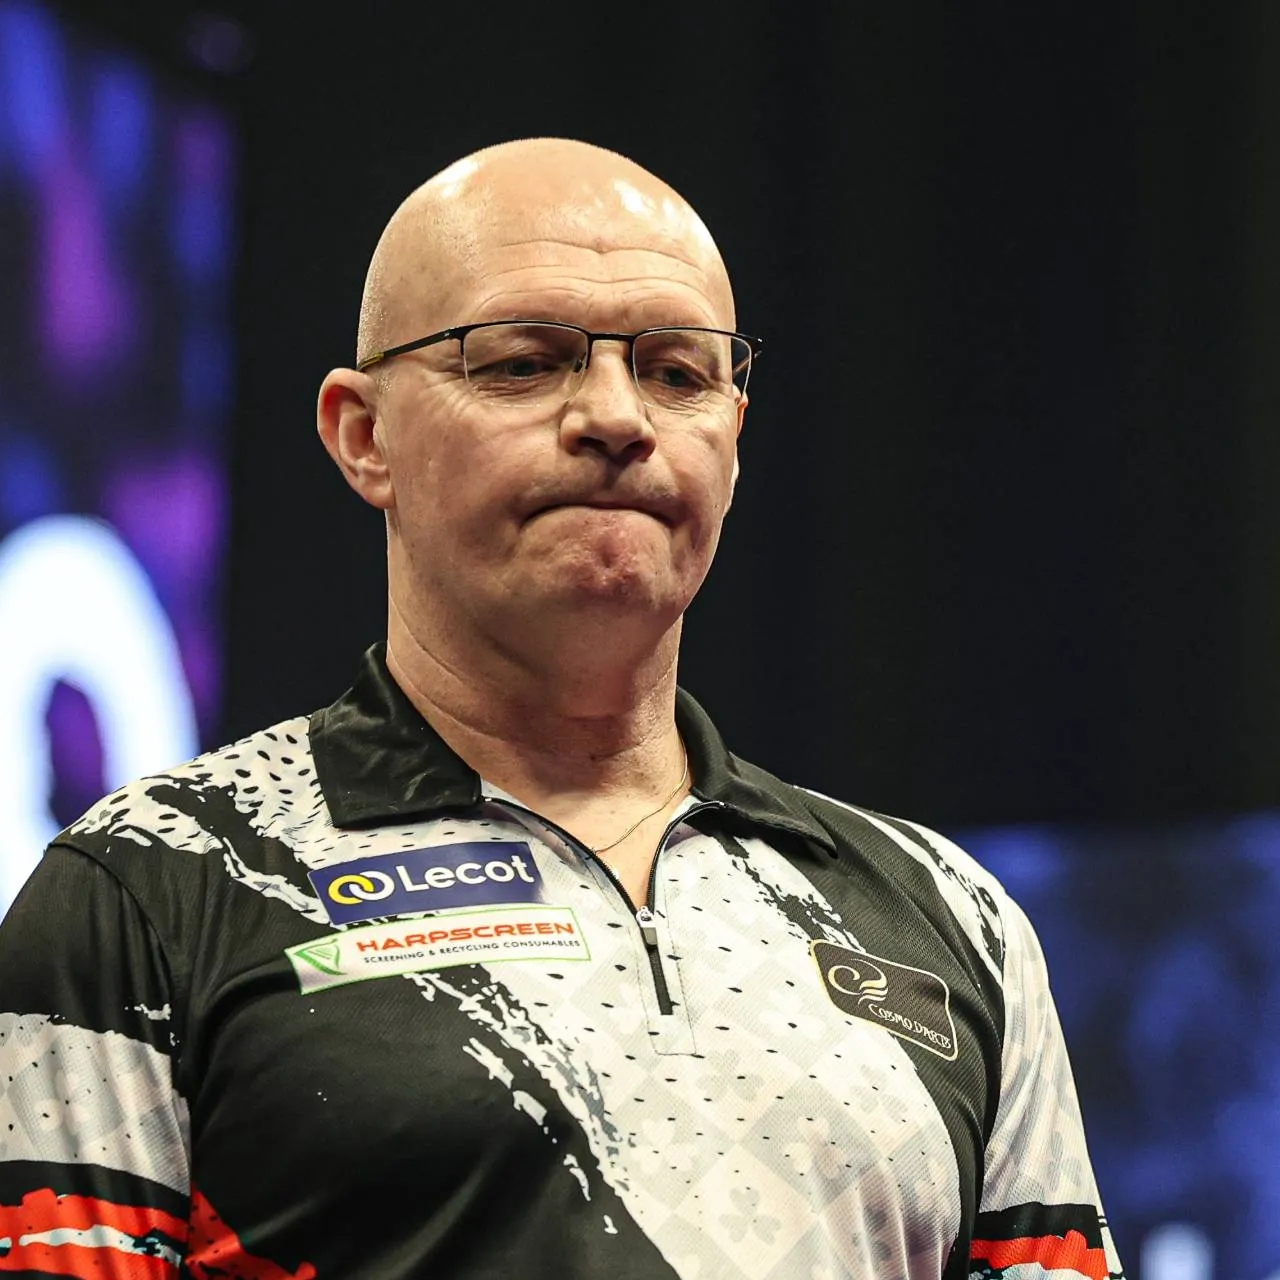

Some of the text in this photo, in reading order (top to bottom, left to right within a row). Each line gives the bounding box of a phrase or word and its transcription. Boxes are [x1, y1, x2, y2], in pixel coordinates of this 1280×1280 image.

[395, 855, 535, 892] Lecot
[356, 922, 576, 953] HARPSCREEN
[363, 950, 425, 963] SCREENING
[439, 942, 500, 955] RECYCLING
[503, 939, 582, 949] CONSUMABLES
